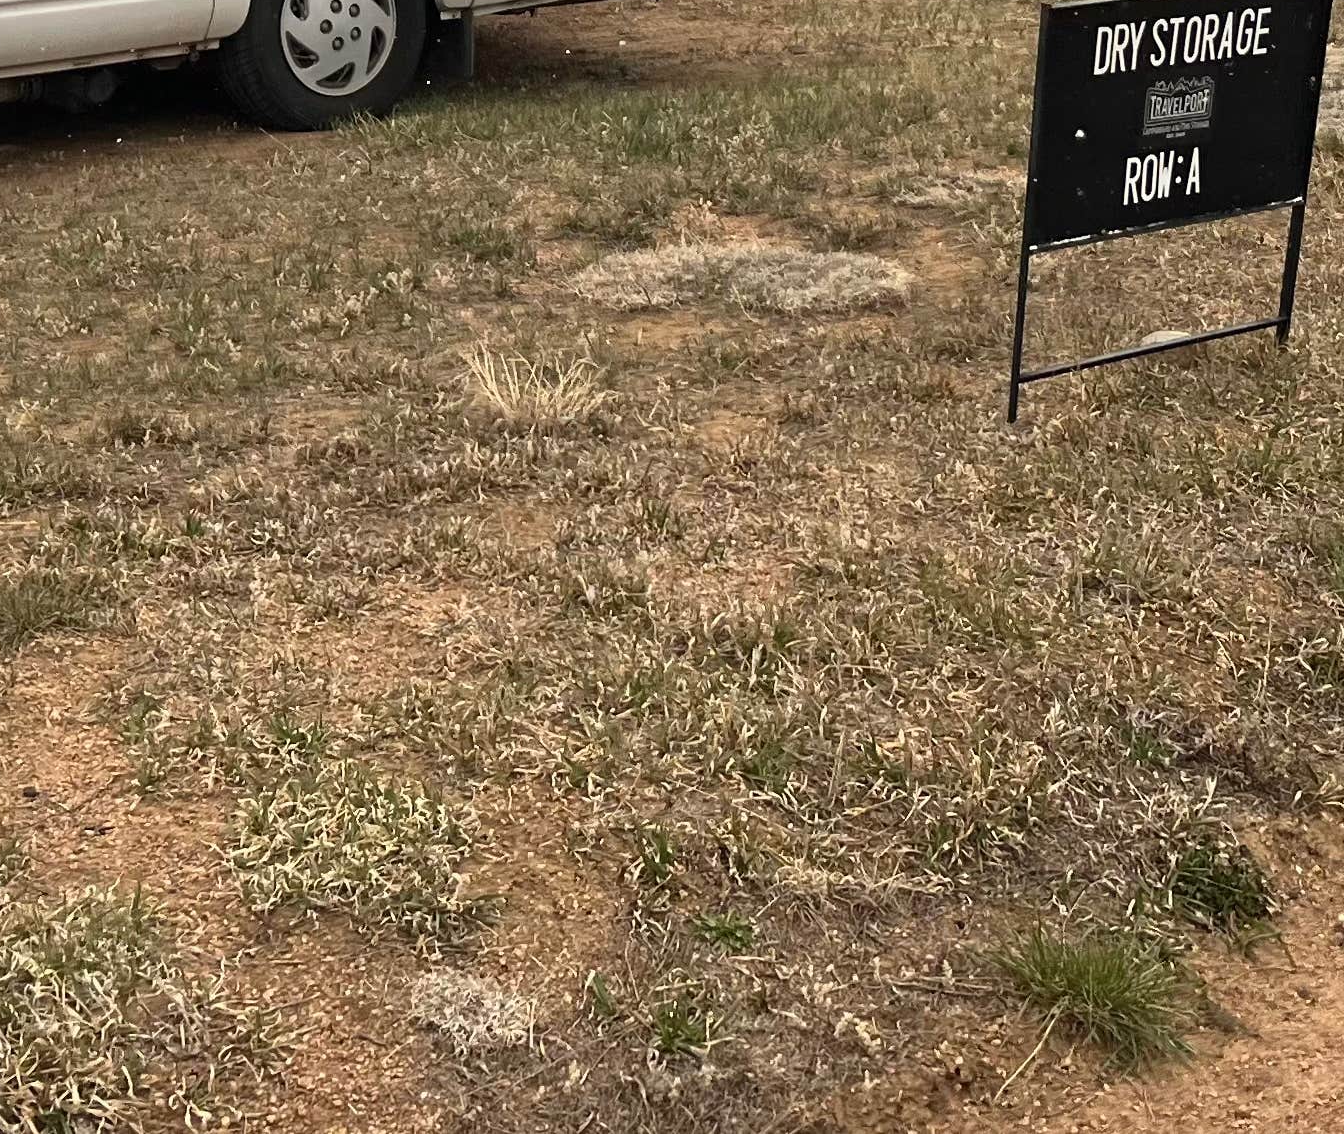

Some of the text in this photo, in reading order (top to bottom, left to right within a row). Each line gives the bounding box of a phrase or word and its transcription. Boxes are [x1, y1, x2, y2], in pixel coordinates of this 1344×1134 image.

[1093, 7, 1272, 76] DRY STORAGE
[1150, 88, 1210, 120] TRAVELPORT
